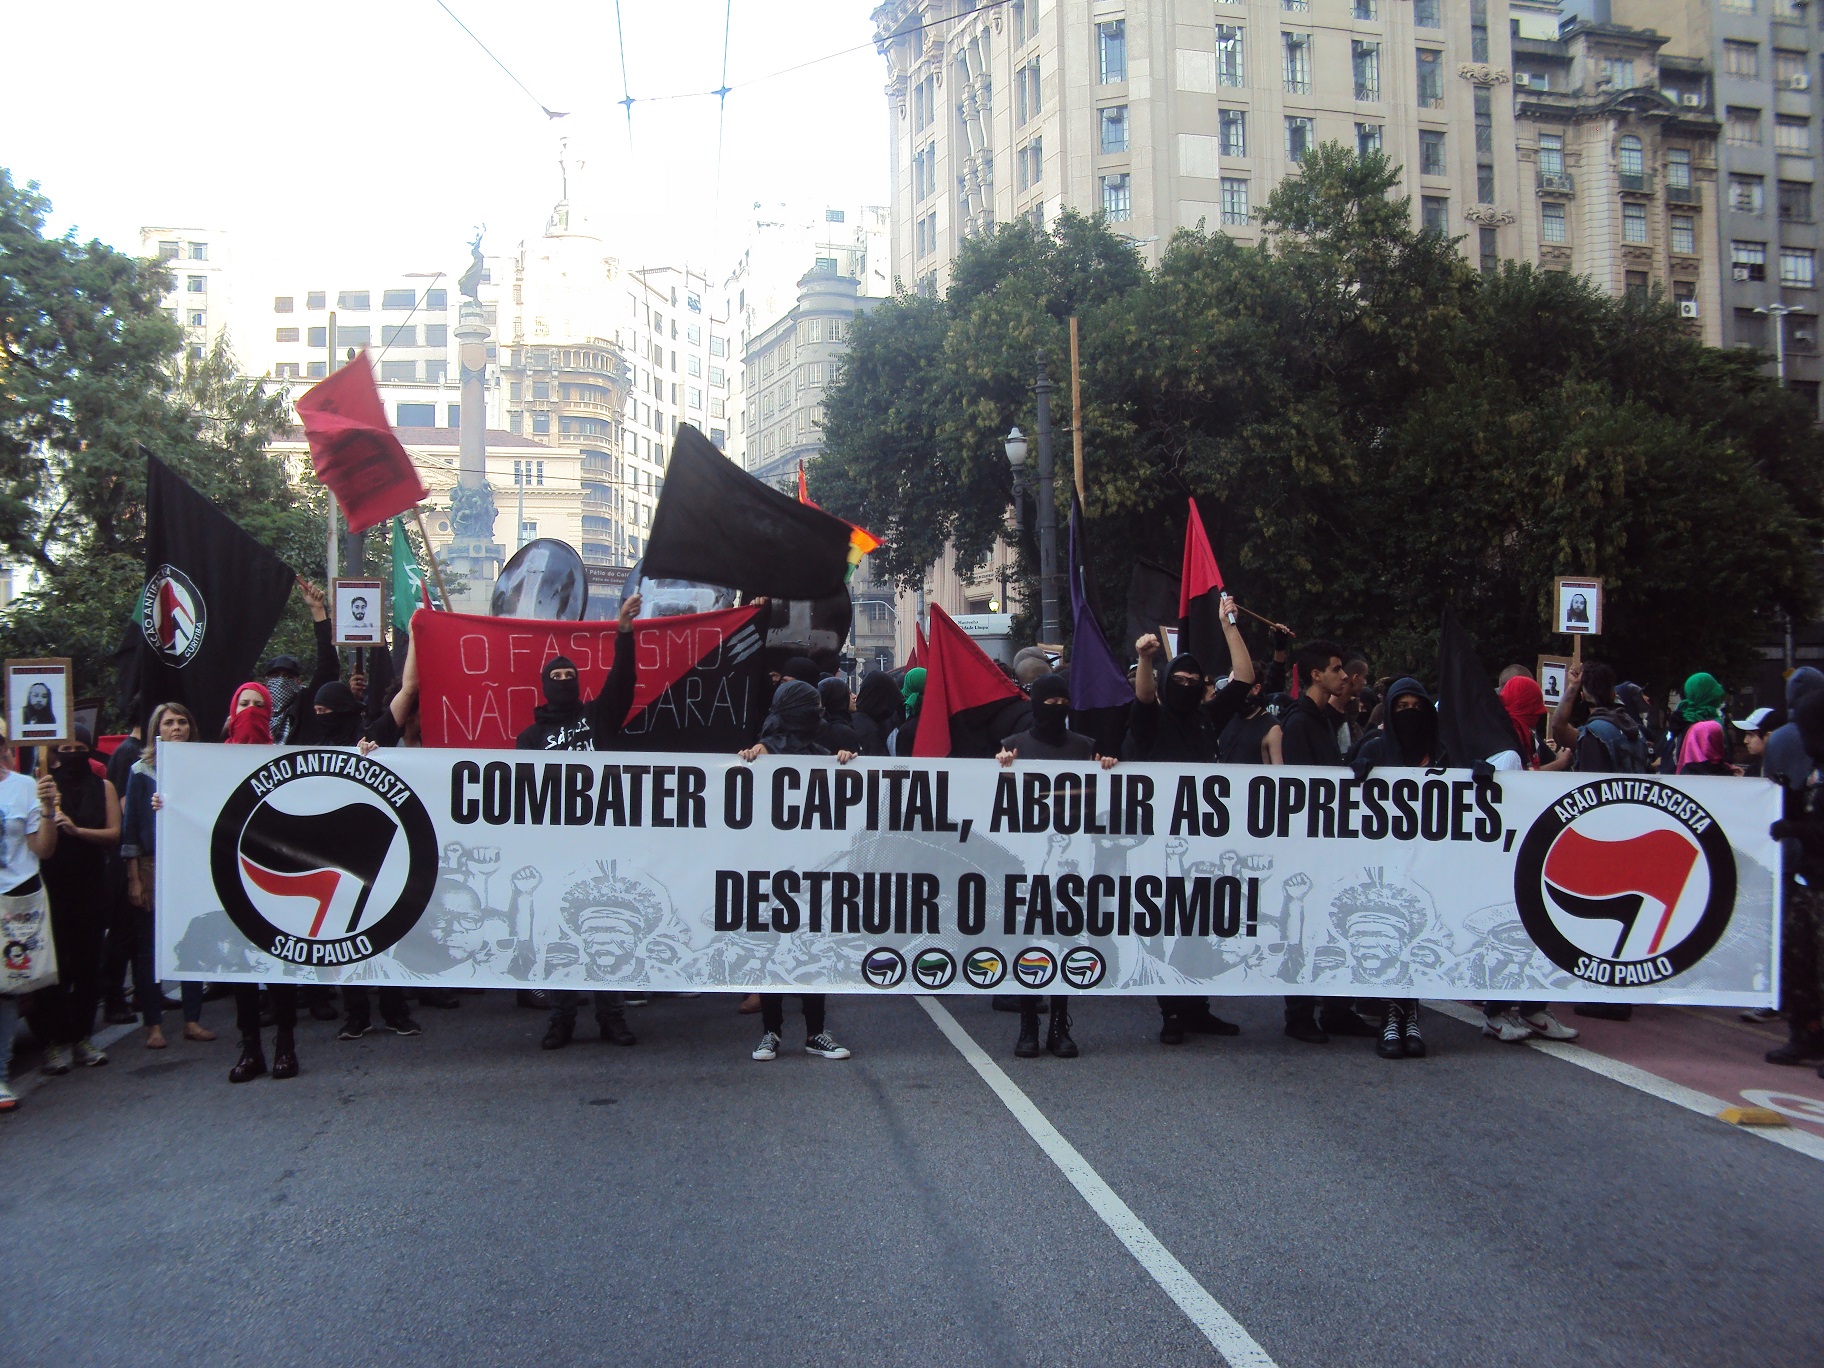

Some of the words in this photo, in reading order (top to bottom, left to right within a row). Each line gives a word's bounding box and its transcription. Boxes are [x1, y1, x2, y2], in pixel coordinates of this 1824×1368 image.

[184, 622, 203, 658] CURITIBA
[460, 634, 489, 675] O
[509, 627, 723, 673] FASCSMO
[442, 682, 538, 744] NÃO
[250, 761, 292, 797] AÇÃO
[296, 753, 411, 808] ANTIFASCISTA
[451, 761, 707, 829] COMBATER
[724, 766, 754, 829] O
[772, 767, 974, 843] CAPITAL,
[990, 772, 1155, 835] ABOLIR
[1169, 775, 1231, 838] AS
[1248, 769, 1517, 853] OPRESSÕES,
[1554, 787, 1598, 823] AÇÃO
[1601, 781, 1712, 835] ANTIFASCISTA
[715, 870, 941, 935] DESTRUIR
[957, 873, 987, 936] O
[1004, 873, 1260, 938] FASCISMO!
[271, 935, 308, 963] SÃO
[312, 935, 373, 965] PAULO
[1573, 956, 1611, 983] SÃO
[1614, 956, 1673, 985] PAULO
